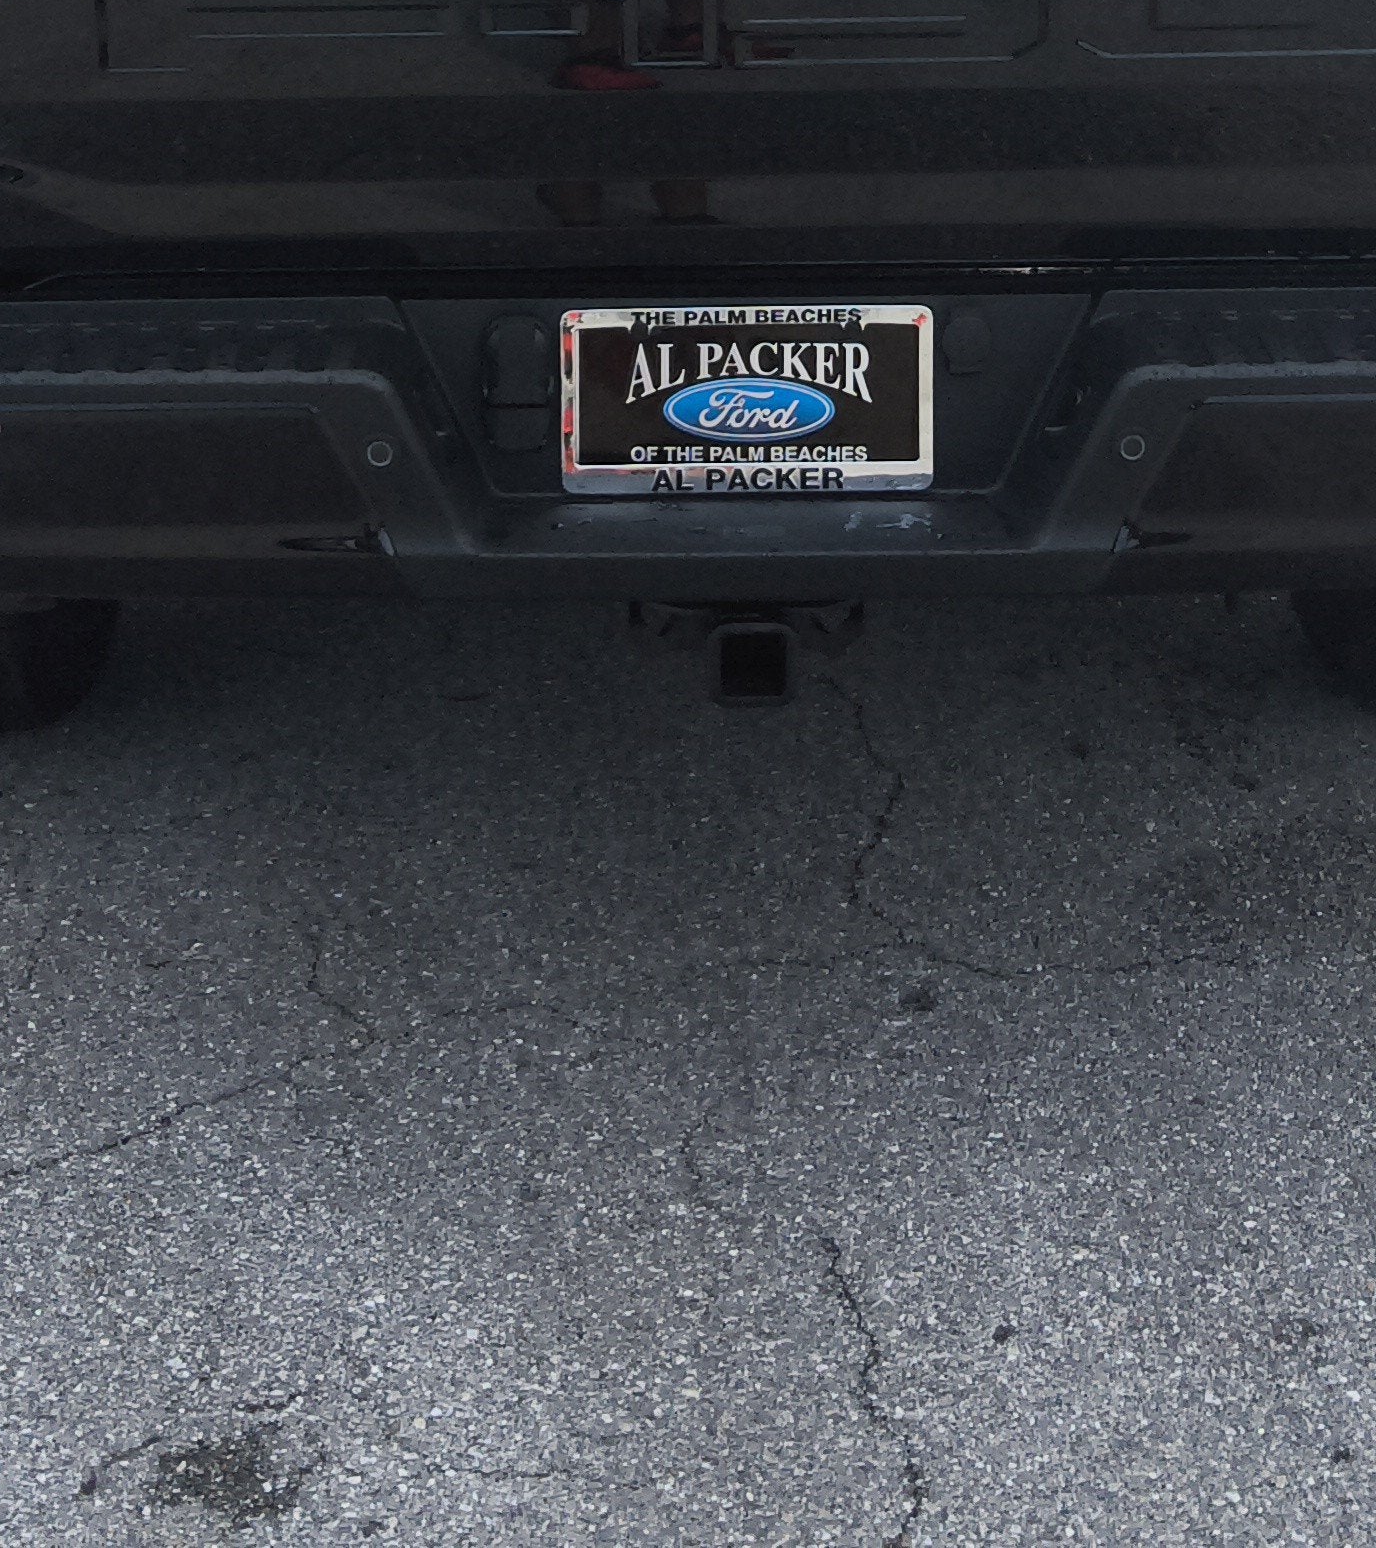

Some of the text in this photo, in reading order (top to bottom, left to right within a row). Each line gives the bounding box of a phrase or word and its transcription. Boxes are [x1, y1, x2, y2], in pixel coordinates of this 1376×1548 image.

[630, 308, 862, 326] THE PALM BEACHES
[625, 342, 873, 404] AL PACKER
[698, 389, 800, 429] Ford
[630, 446, 868, 462] OF THE PALM BEACHES
[651, 467, 844, 492] AL PACKER
